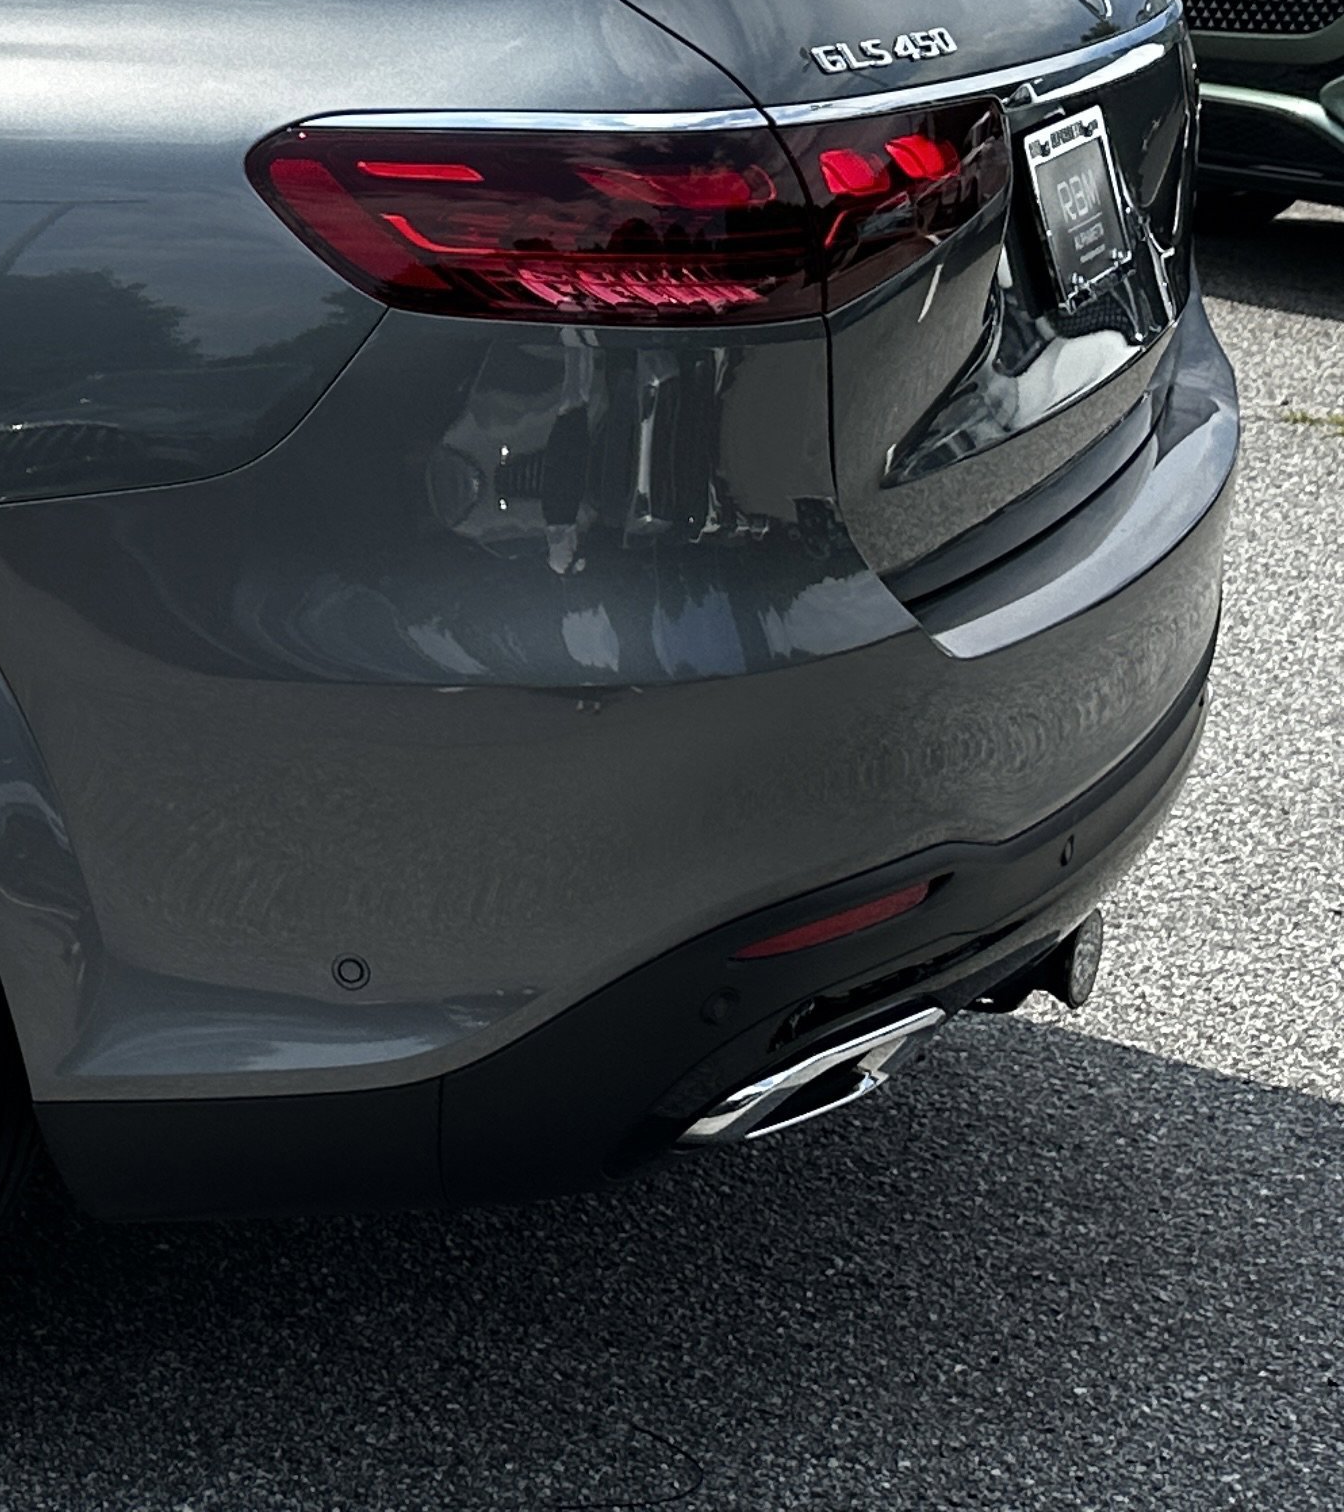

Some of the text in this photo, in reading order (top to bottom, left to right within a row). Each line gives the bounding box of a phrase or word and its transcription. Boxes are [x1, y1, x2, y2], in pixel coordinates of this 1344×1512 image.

[810, 26, 958, 75] GLS 450
[1056, 168, 1101, 223] RBM
